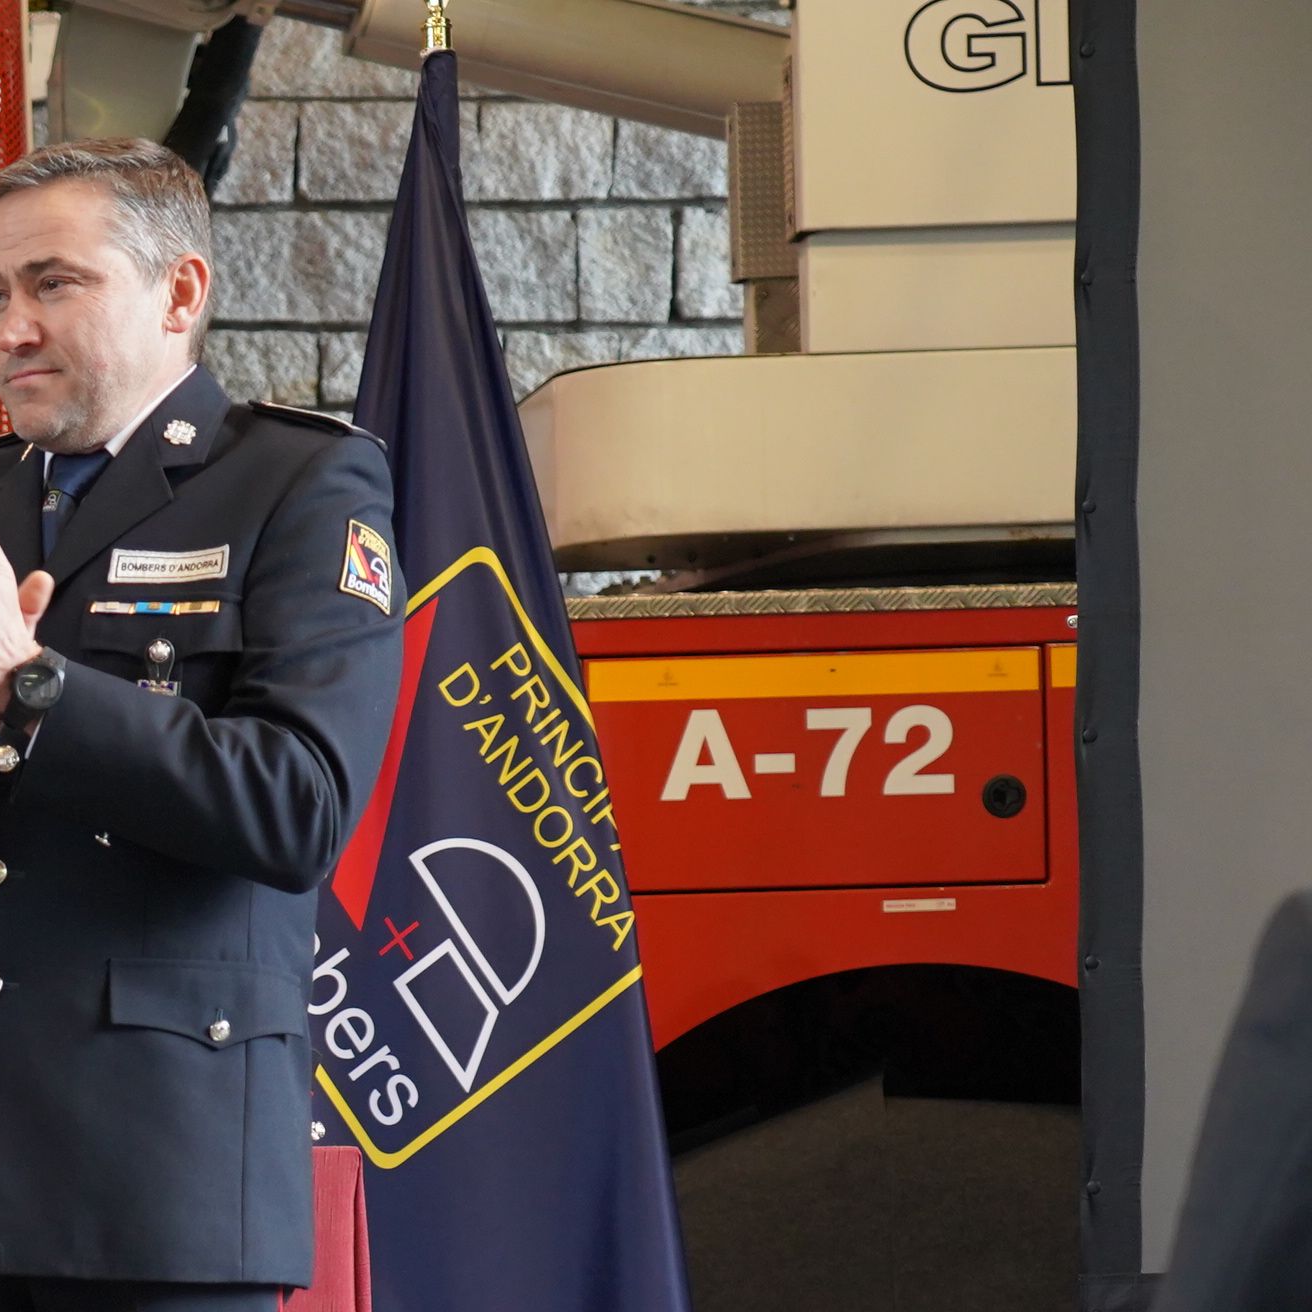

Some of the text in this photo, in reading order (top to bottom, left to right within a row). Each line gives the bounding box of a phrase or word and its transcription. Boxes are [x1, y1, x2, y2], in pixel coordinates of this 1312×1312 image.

[121, 562, 167, 572] BOMBERS
[438, 661, 636, 952] D'ANDORRA
[659, 704, 956, 801] A-72
[307, 930, 419, 1126] bers
